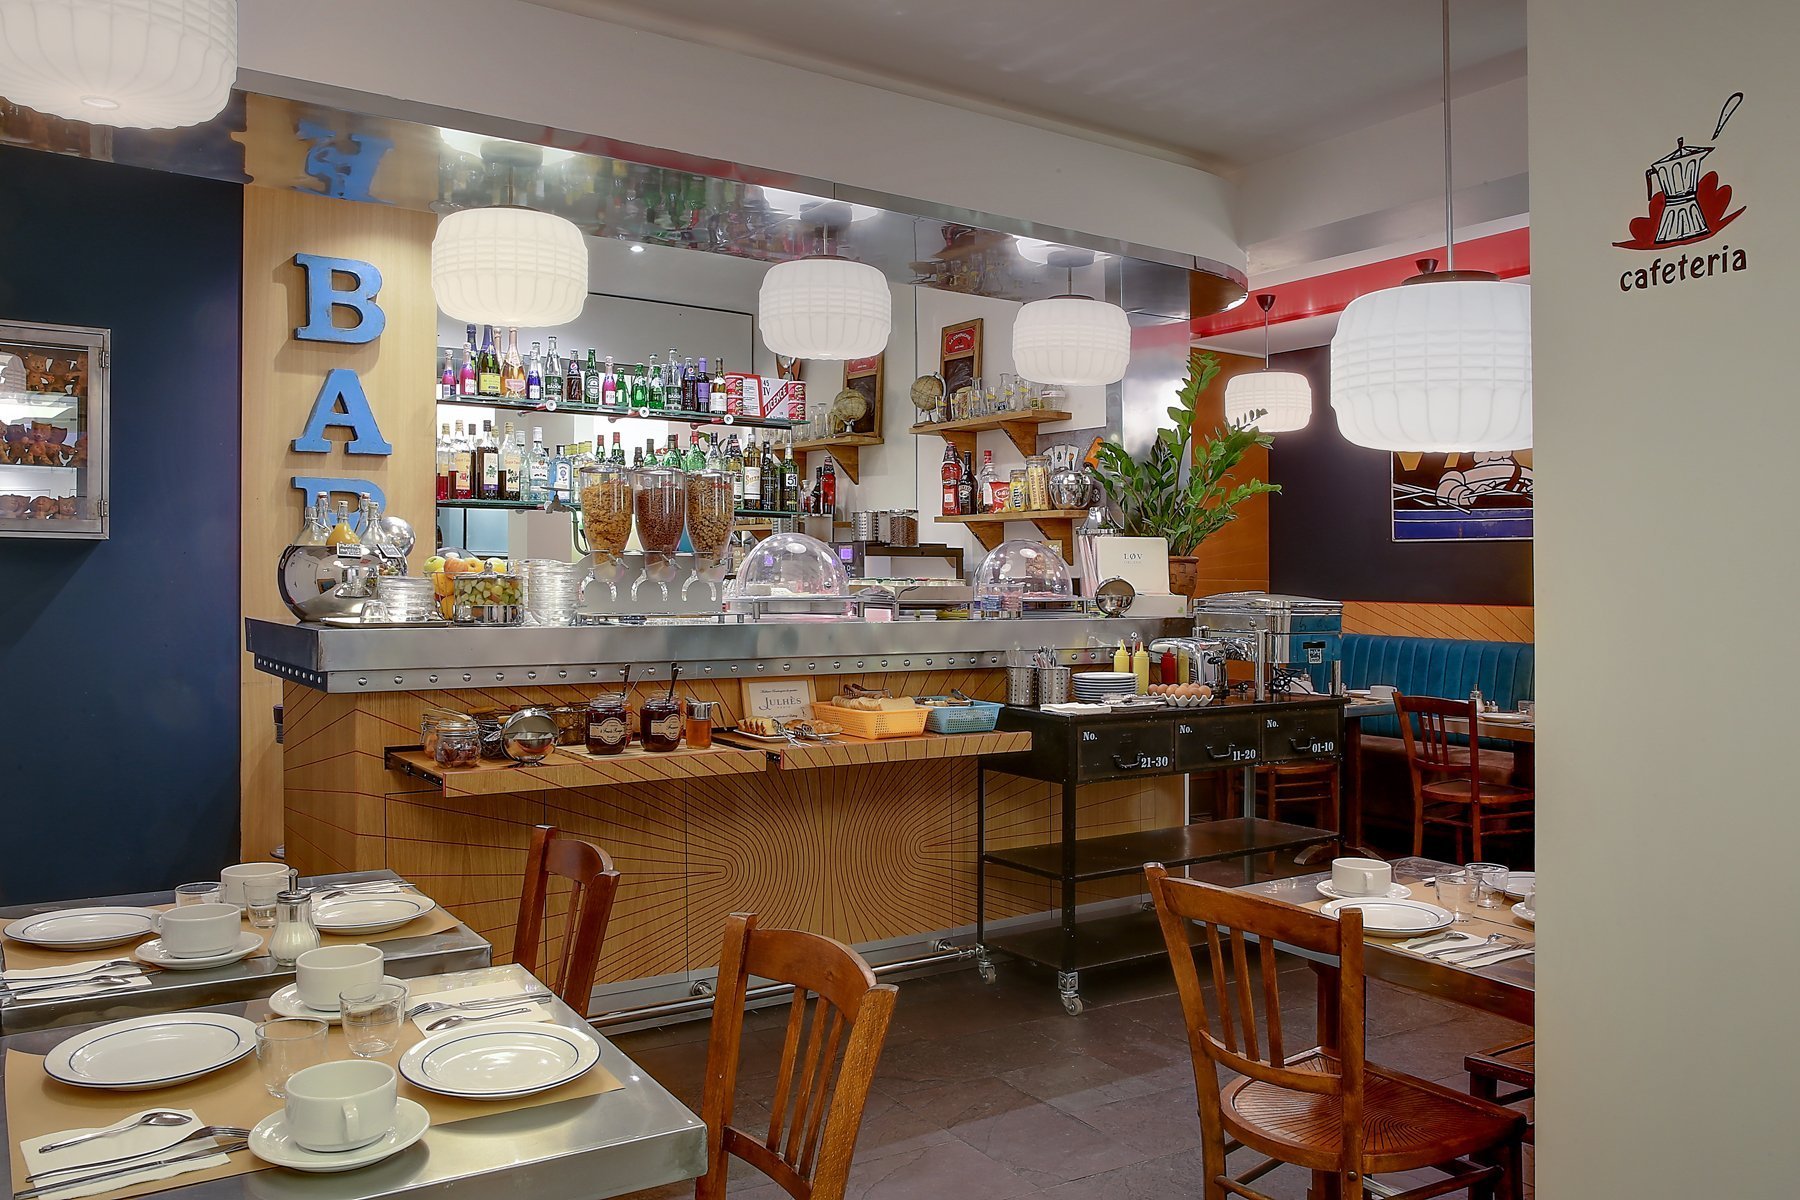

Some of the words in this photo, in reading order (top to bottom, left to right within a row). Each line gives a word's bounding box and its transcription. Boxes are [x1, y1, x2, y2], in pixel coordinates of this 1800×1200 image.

[1620, 245, 1747, 292] cafeteria
[762, 387, 771, 396] IV
[763, 385, 788, 414] LICENCE
[786, 475, 798, 486] 51
[1123, 552, 1143, 561] LØV
[758, 695, 802, 711] JULHÈS
[1265, 719, 1279, 728] No.
[1179, 725, 1193, 734] No.
[1082, 731, 1098, 741] No.
[1311, 741, 1334, 753] 01-10
[1232, 749, 1256, 761] 11-20
[1140, 756, 1168, 768] 21-30
